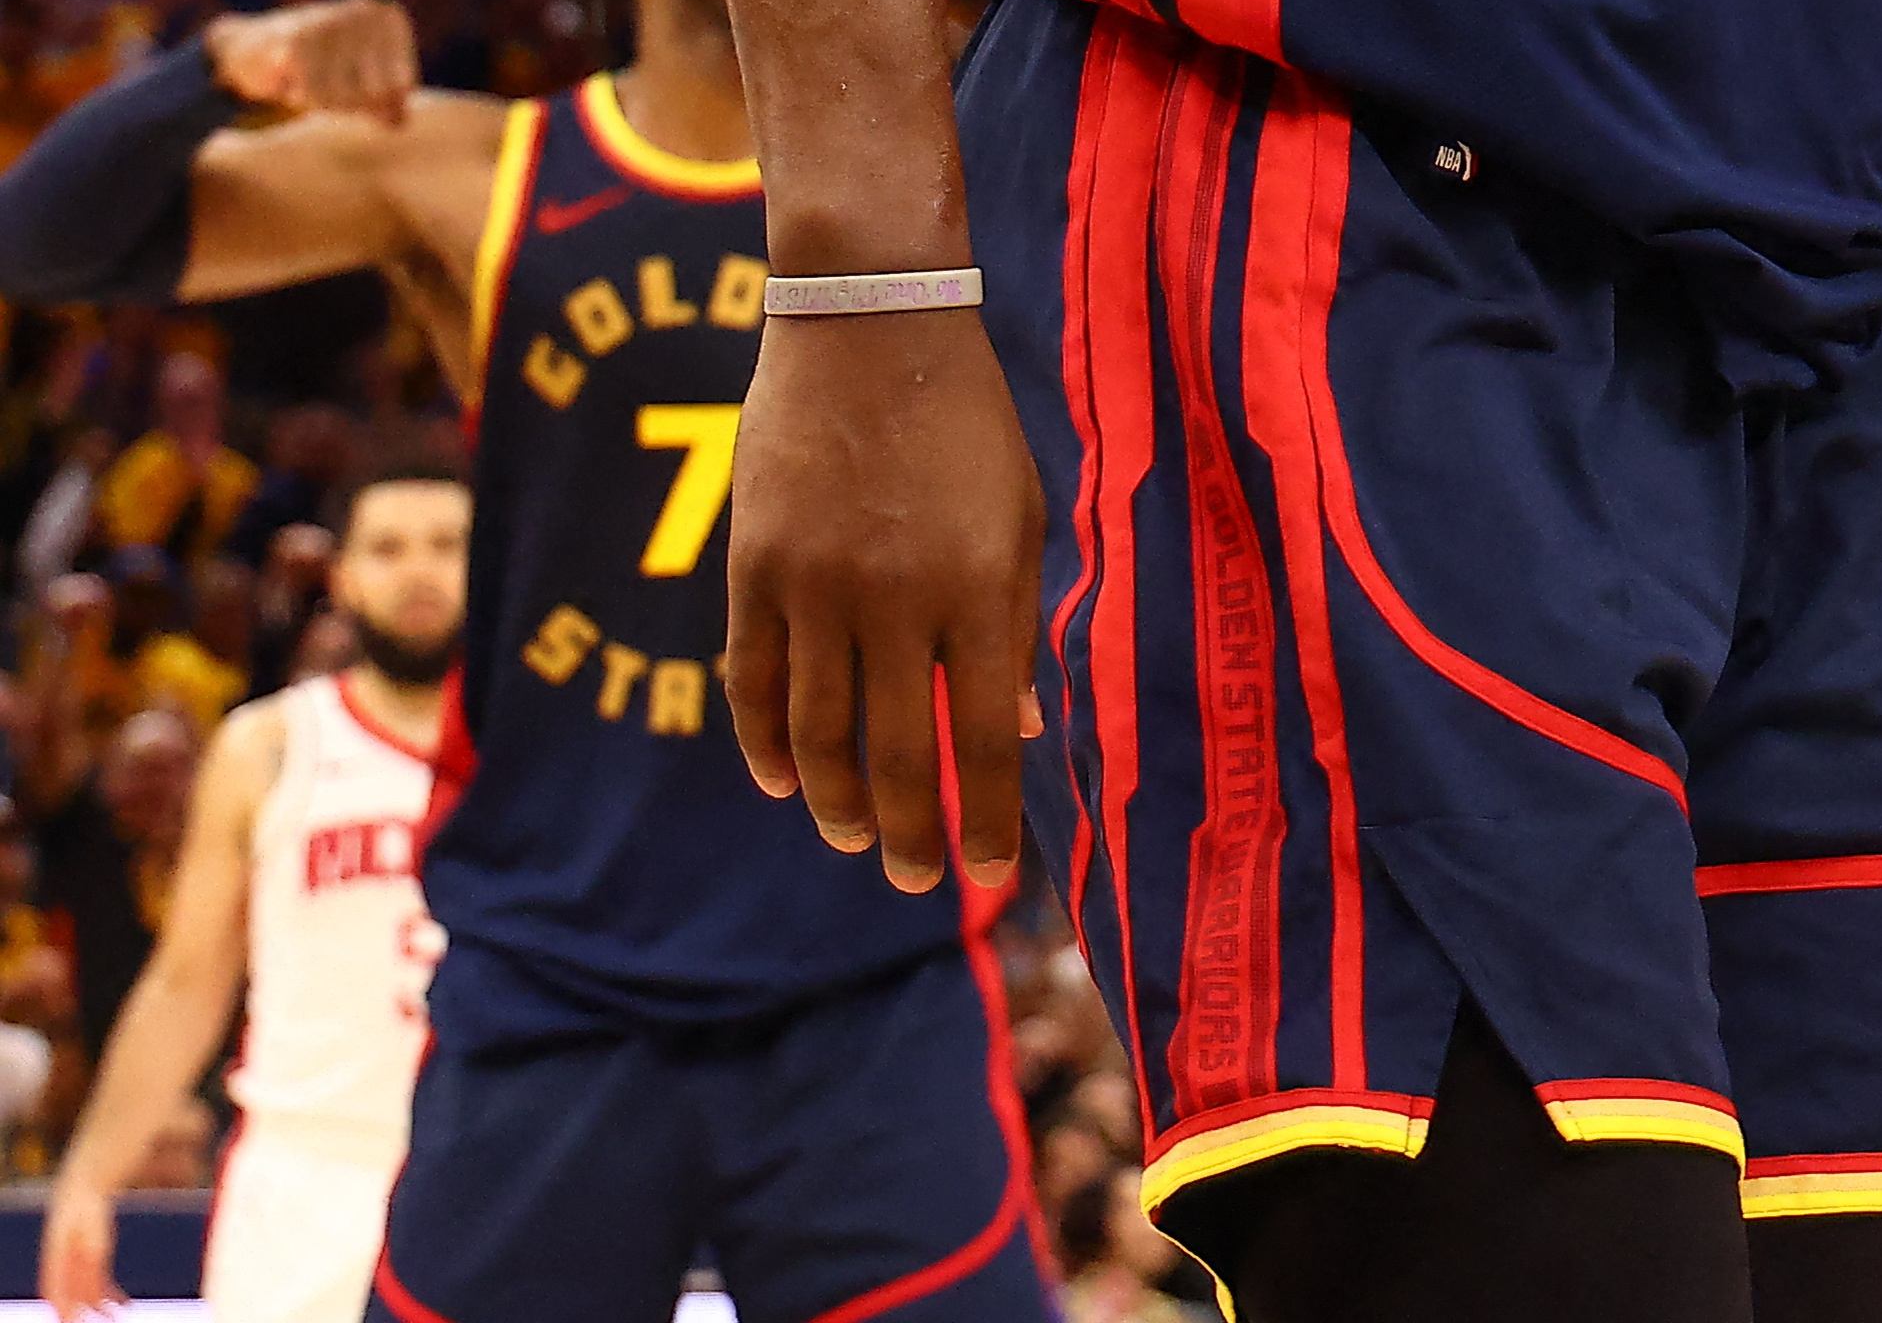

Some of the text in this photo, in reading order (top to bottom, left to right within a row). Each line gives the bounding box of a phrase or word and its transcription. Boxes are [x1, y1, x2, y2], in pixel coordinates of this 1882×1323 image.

[1435, 145, 1462, 173] NBA
[635, 401, 746, 578] 7
[1198, 483, 1262, 671] GOLDEN
[520, 602, 727, 739] STA
[1221, 681, 1267, 831] STATE
[1197, 837, 1253, 1077] WARRIORS
